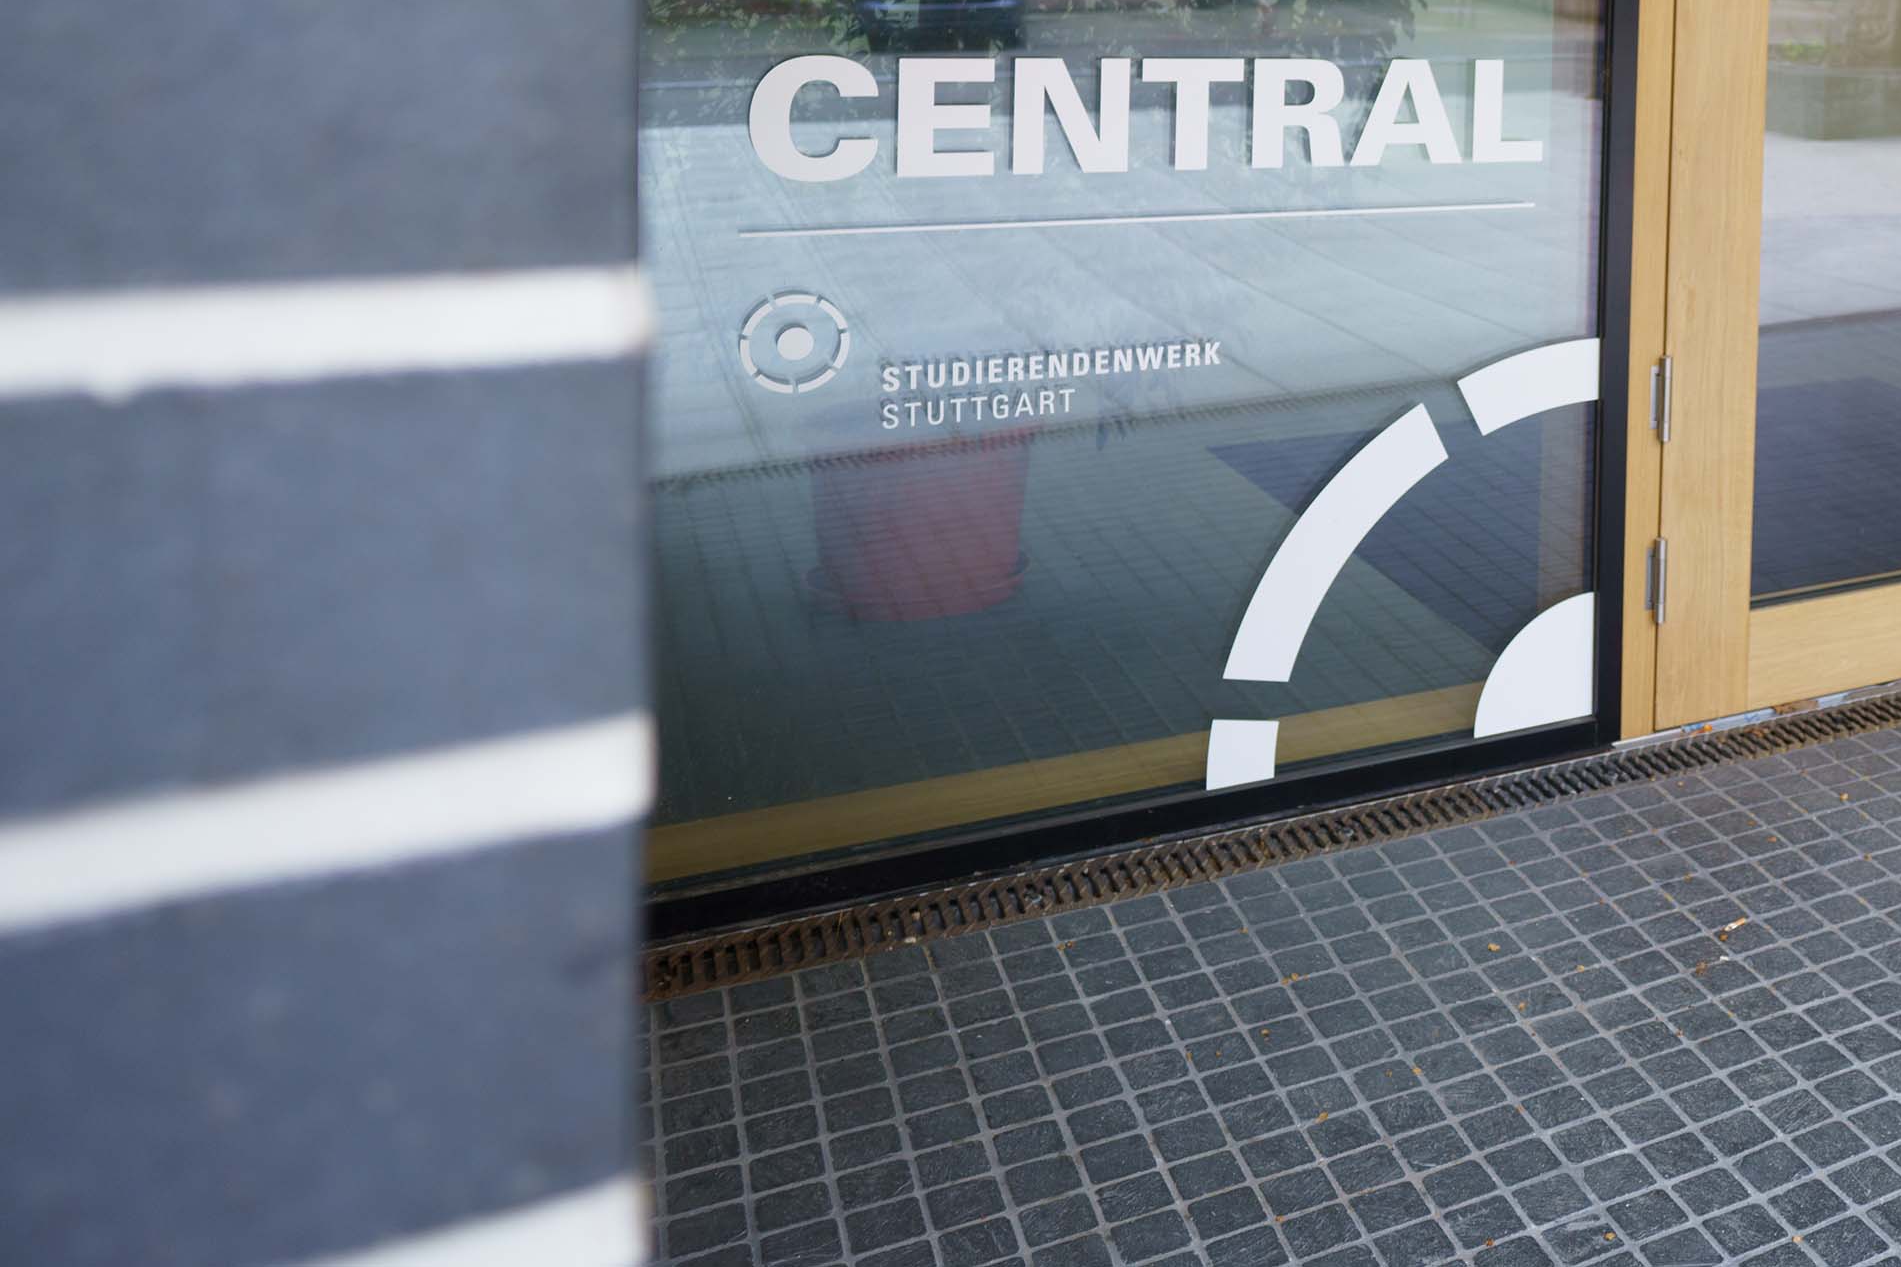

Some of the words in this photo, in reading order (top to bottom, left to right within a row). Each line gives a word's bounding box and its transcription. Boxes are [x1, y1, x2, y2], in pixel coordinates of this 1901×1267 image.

[747, 54, 1545, 182] CENTRAL
[882, 341, 1222, 393] STUDIERENDENWERK
[881, 388, 1077, 430] STUTTGART
